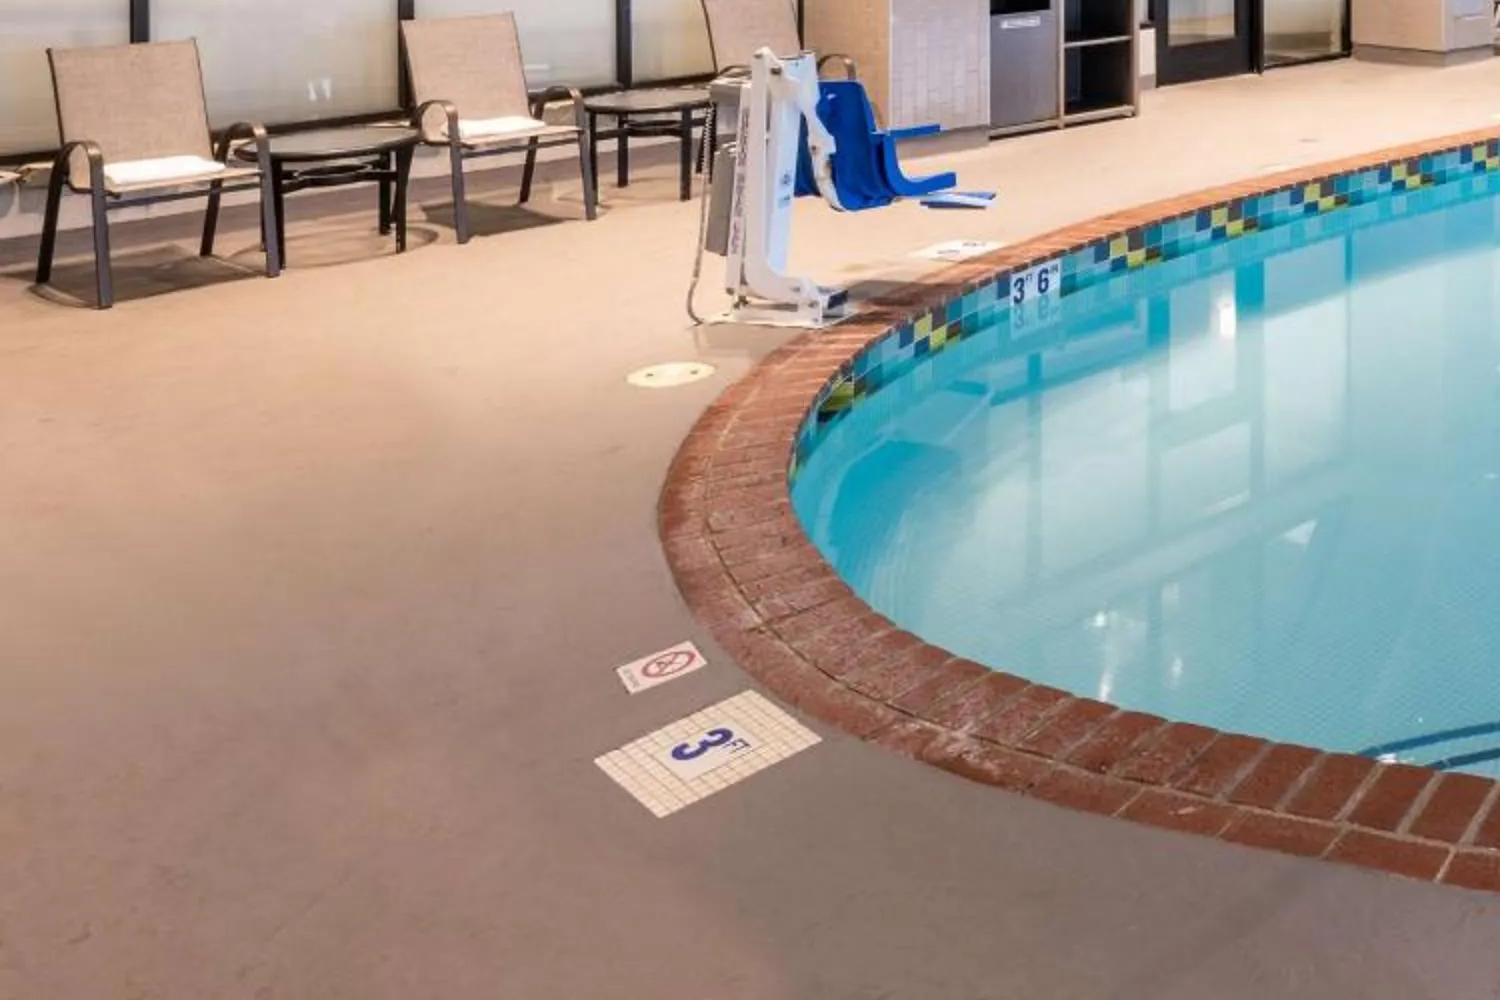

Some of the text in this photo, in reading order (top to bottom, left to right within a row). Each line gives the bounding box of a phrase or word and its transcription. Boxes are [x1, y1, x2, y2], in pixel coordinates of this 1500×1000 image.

[1013, 277, 1025, 304] 3
[1037, 268, 1050, 294] 6
[671, 727, 733, 760] 3
